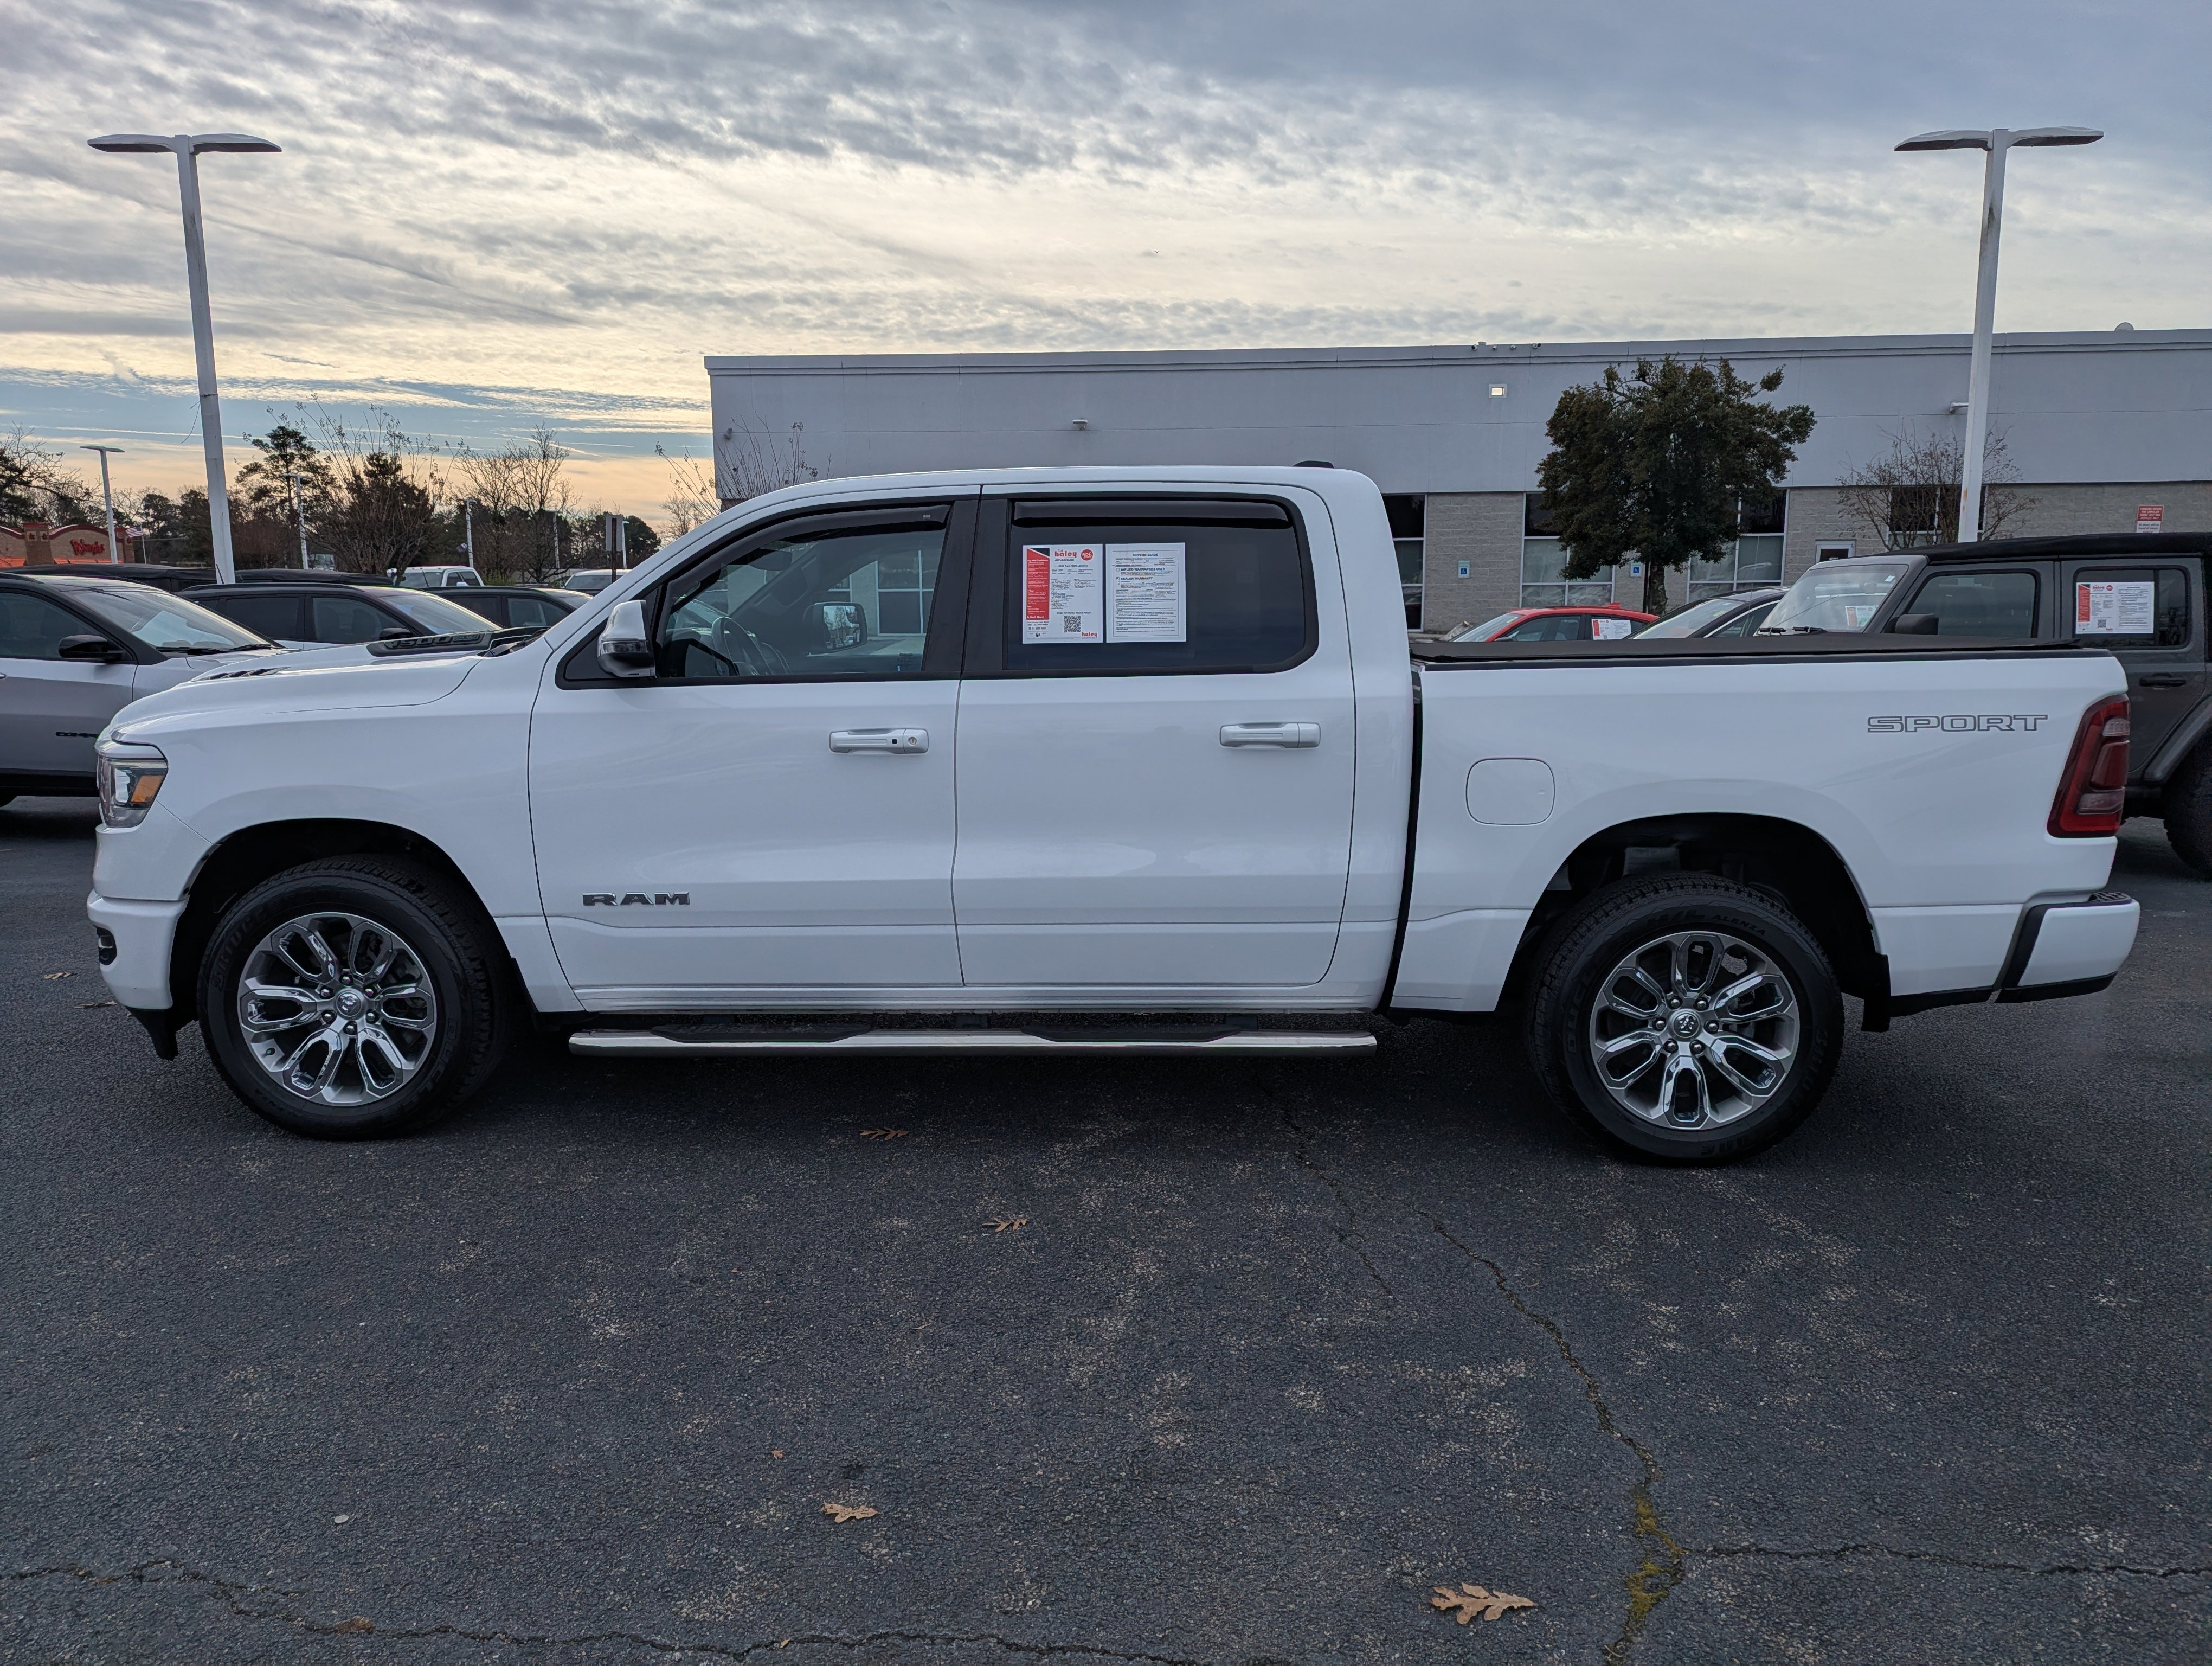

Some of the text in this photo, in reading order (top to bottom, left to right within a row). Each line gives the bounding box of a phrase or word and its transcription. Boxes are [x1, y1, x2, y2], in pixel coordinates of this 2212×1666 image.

[1867, 715, 2048, 733] SPORT
[582, 892, 690, 906] RAM
[1711, 914, 1767, 937] ALENZA
